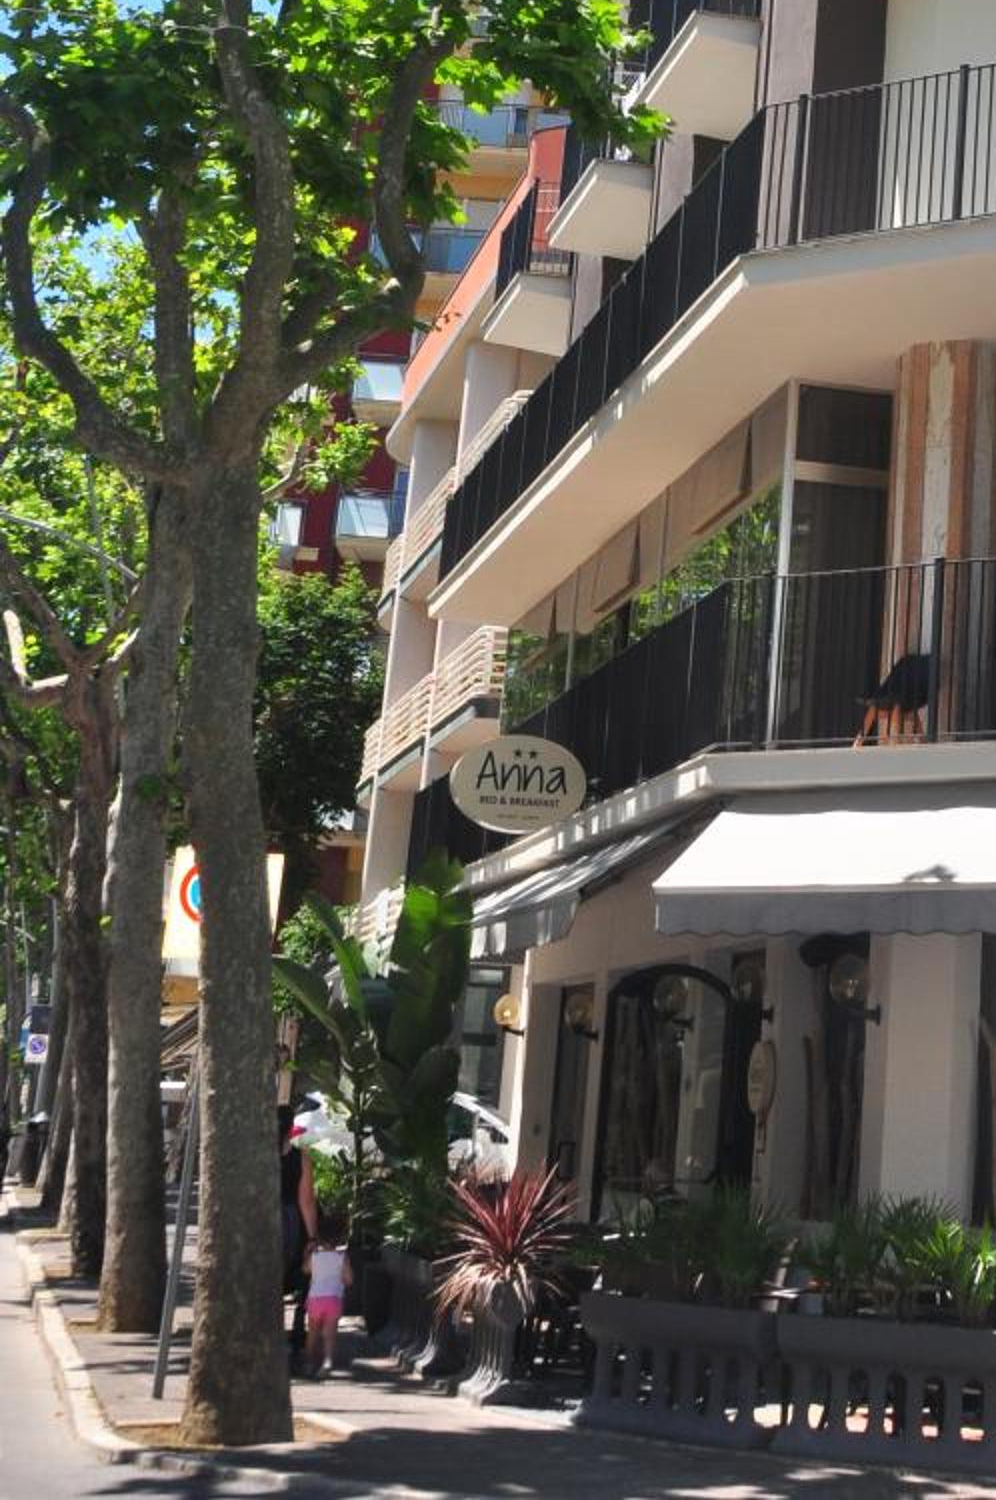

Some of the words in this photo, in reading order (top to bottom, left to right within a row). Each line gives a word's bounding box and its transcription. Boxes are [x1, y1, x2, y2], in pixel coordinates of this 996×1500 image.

[476, 750, 567, 795] Anna
[479, 795, 497, 805] BED
[499, 796, 508, 805] &
[510, 796, 560, 808] BREAKFAST
